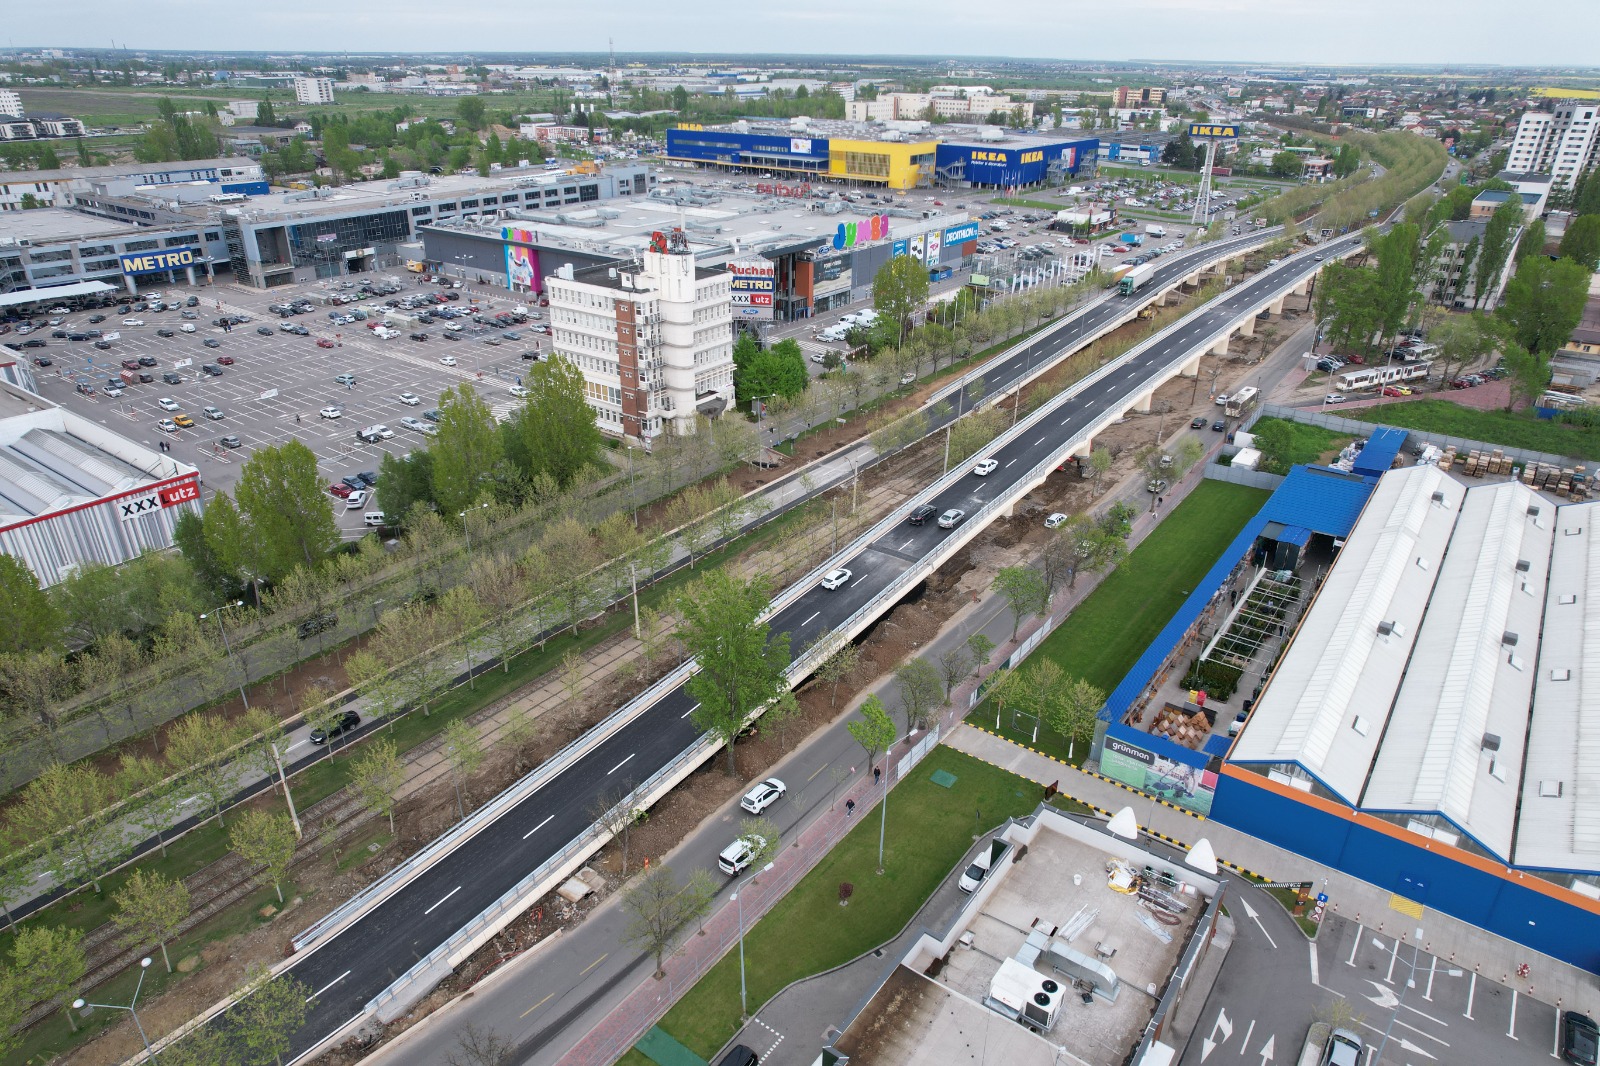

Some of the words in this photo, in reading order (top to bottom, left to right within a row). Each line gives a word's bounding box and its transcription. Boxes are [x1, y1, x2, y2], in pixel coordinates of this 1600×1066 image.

[1192, 126, 1235, 136] IKEA
[972, 151, 1007, 162] IKEA
[1021, 151, 1043, 164] IKEA
[833, 214, 889, 251] JUMBO
[123, 251, 193, 272] METRO
[728, 263, 774, 276] Auchan
[731, 280, 773, 290] METRO
[1112, 742, 1150, 761] grünman
